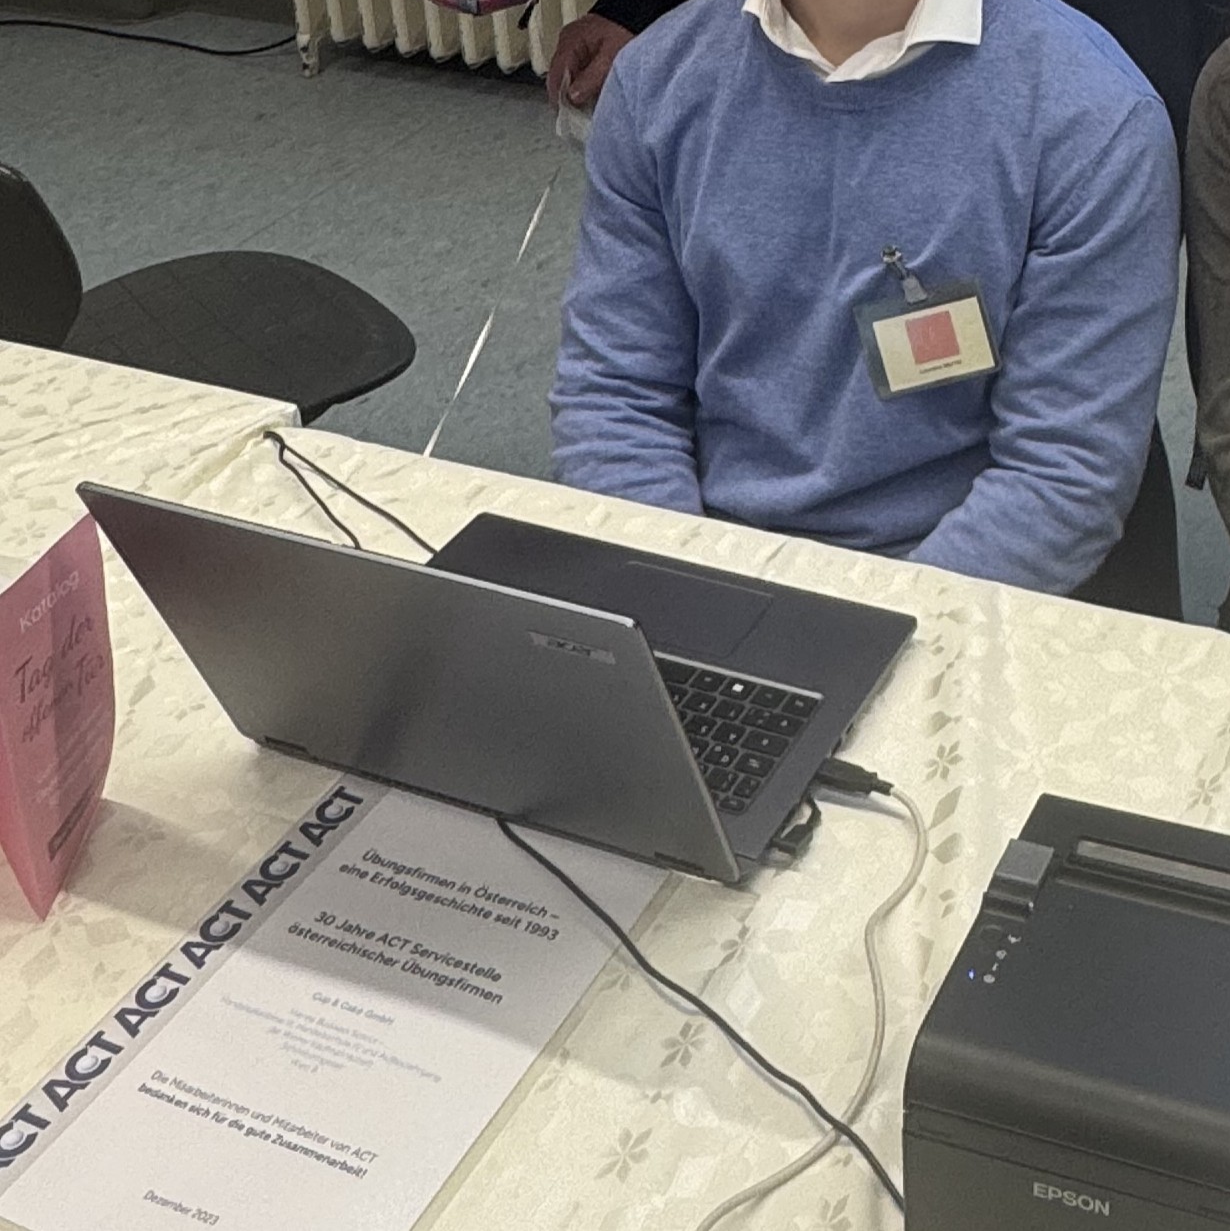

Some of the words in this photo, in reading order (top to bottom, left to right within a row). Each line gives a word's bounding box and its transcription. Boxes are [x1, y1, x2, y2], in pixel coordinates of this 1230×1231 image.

[19, 570, 80, 633] Katalog
[14, 655, 54, 704] Tag
[338, 862, 369, 880] eine
[369, 871, 494, 920] Erfolgsgeschichte
[493, 910, 523, 930] seit
[523, 920, 560, 942] 1993
[362, 847, 456, 891] Übungsfirmen
[457, 881, 473, 896] in
[473, 881, 549, 919] Österreich
[0, 1103, 52, 1168] CT
[41, 1029, 124, 1114] ACT
[113, 962, 192, 1039] ACT
[180, 898, 253, 970] ACT
[241, 839, 311, 907] ACT
[299, 785, 365, 848] ACT
[287, 922, 401, 969] österreichischer
[400, 957, 504, 1005] Übungsfirmen
[314, 911, 336, 927] 30
[335, 920, 376, 941] Jahre
[375, 932, 412, 952] ACT
[409, 943, 502, 983] Servicestelle
[137, 1082, 189, 1110] bedanken
[188, 1101, 211, 1119] sich
[210, 1109, 229, 1126] für
[227, 1117, 246, 1132] die
[243, 1125, 272, 1142] gute
[270, 1133, 368, 1180] Zusammenarbeit!
[151, 1069, 170, 1085] Die
[169, 1076, 251, 1116] Mitarbeiterinnen
[250, 1109, 274, 1126] und
[271, 1115, 330, 1147] Mitarbeiter
[330, 1139, 352, 1154] von
[350, 1147, 379, 1165] ACT
[143, 1189, 193, 1217] Dezember
[191, 1206, 220, 1227] 2023
[1032, 1181, 1111, 1217] EPSON
